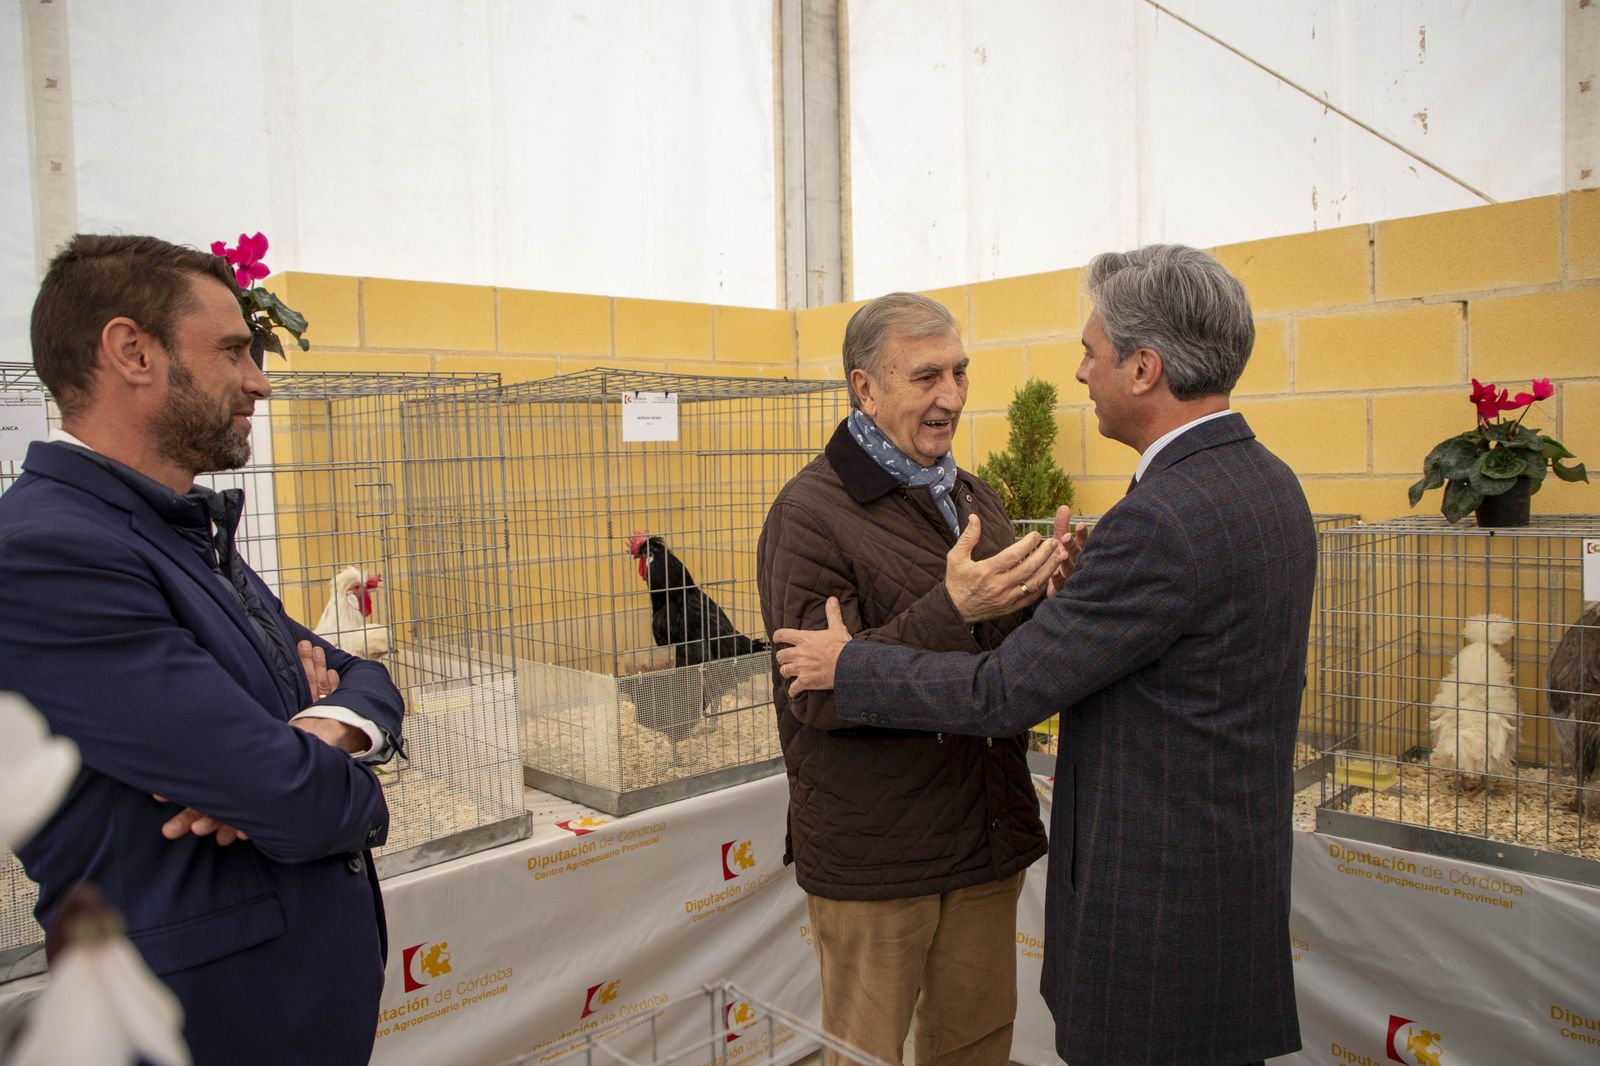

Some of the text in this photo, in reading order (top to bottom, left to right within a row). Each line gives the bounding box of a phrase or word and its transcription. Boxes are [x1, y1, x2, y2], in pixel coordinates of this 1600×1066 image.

[528, 820, 668, 871] Diputación de Córdoba
[534, 835, 660, 880] Centro Agropecuario Provincial
[1329, 844, 1524, 897] Diputación de Córdoba
[1337, 863, 1513, 909] Centro Agropecuario Provincial
[684, 884, 742, 914] Diputación
[744, 880, 757, 893] de
[375, 983, 508, 1038] tro Agropecuario Provincial
[377, 966, 513, 1024] tación de Córdoba
[619, 990, 669, 1017] Córdoba
